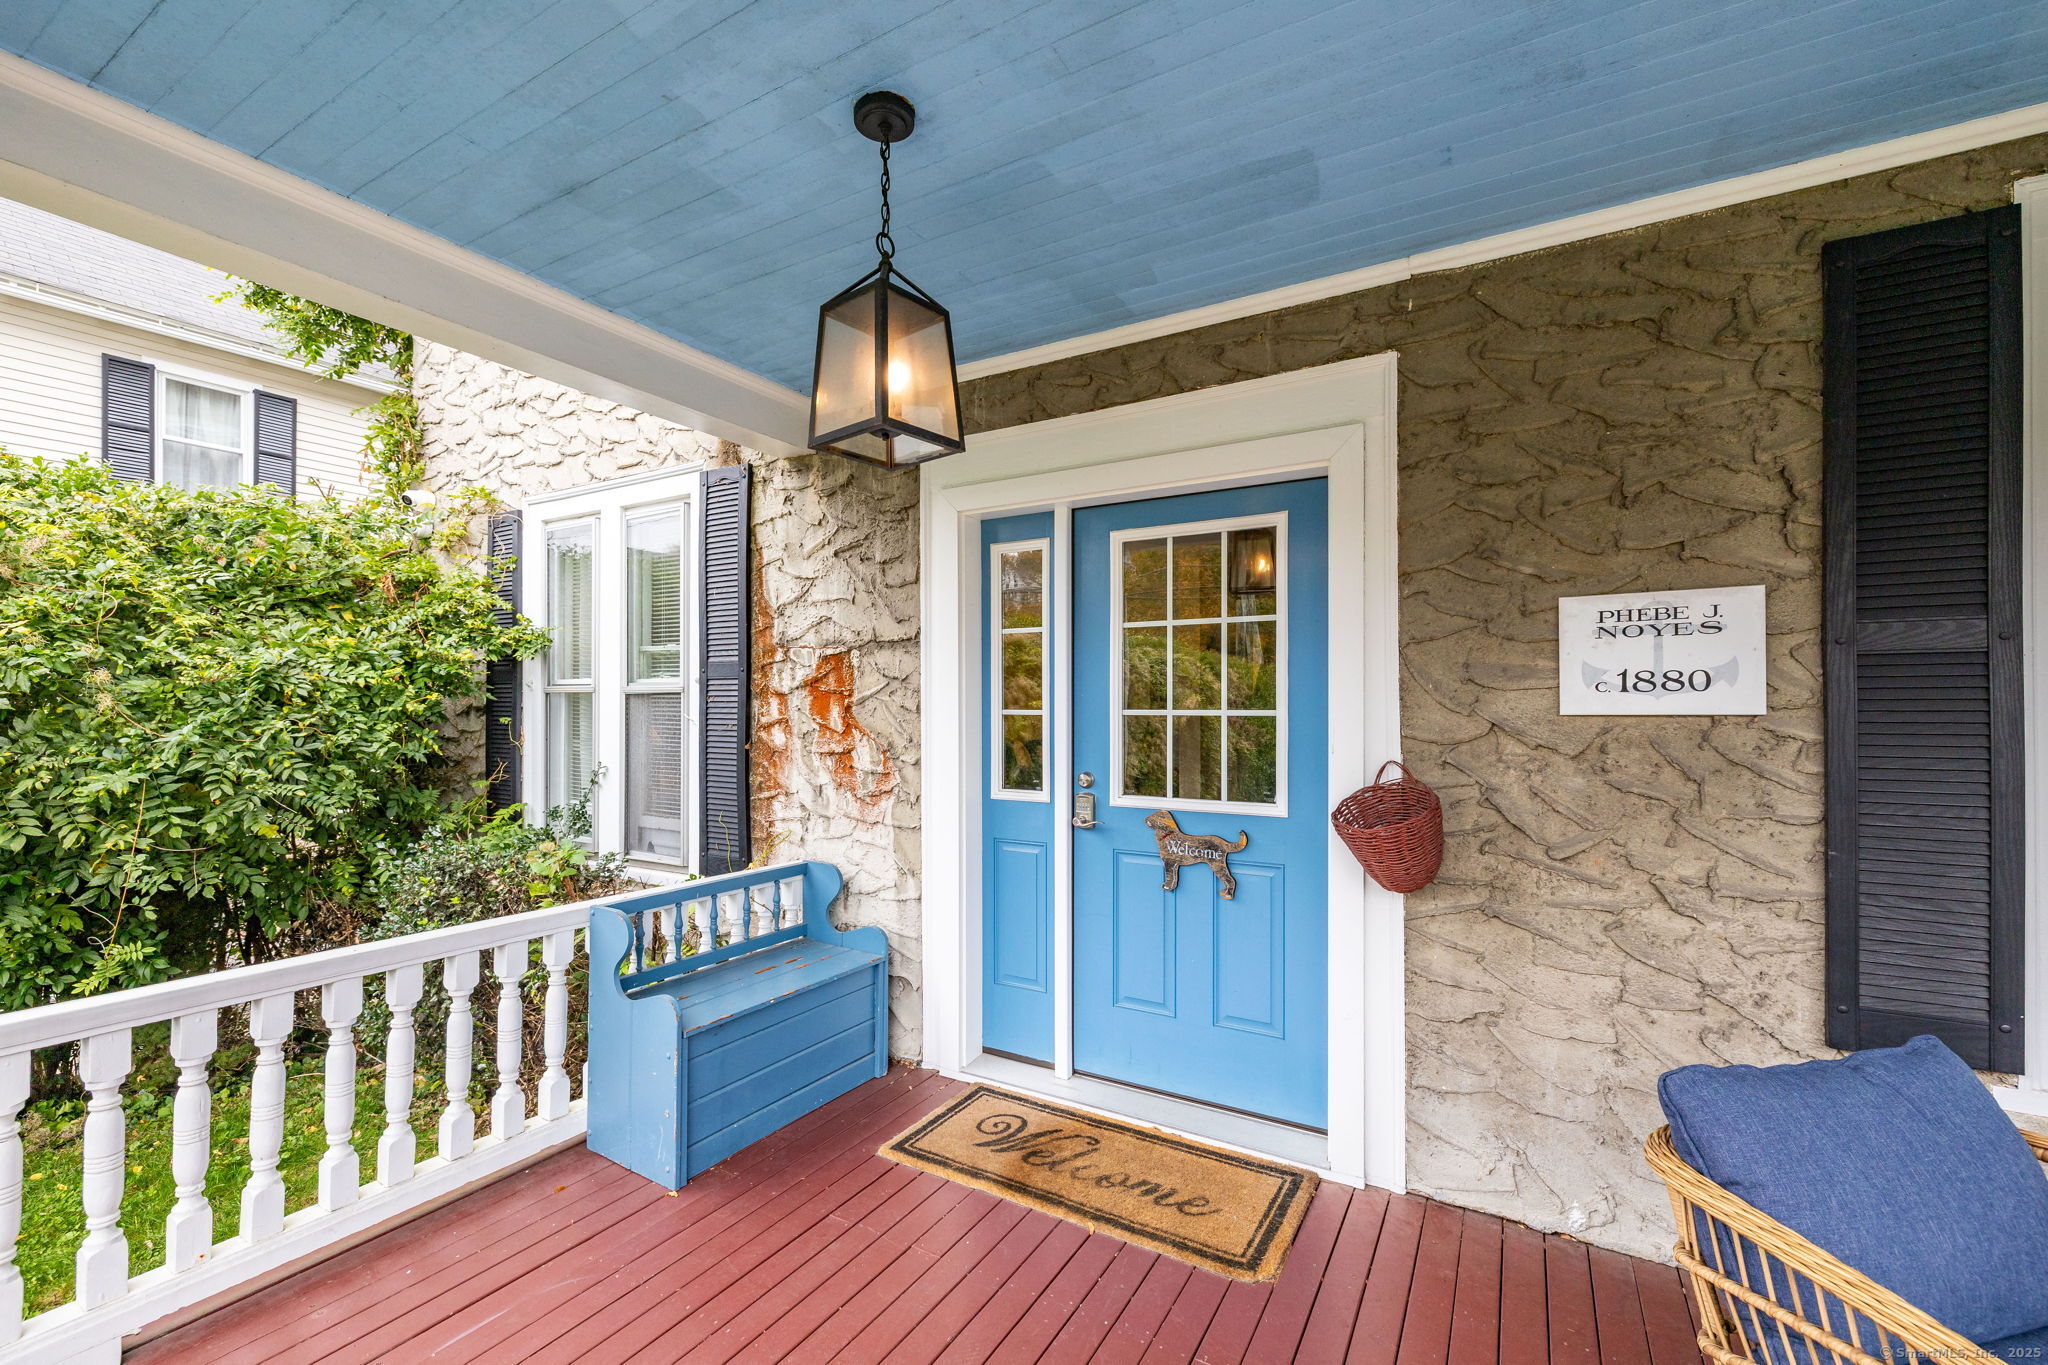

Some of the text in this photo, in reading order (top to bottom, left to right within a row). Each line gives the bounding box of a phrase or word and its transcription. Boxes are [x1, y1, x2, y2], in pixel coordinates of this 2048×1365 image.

[1596, 604, 1724, 623] PHEBE J.
[1595, 620, 1724, 640] NOYES
[1616, 668, 1712, 693] 1880
[1166, 840, 1223, 859] Welcome
[974, 1113, 1222, 1216] Welcome
